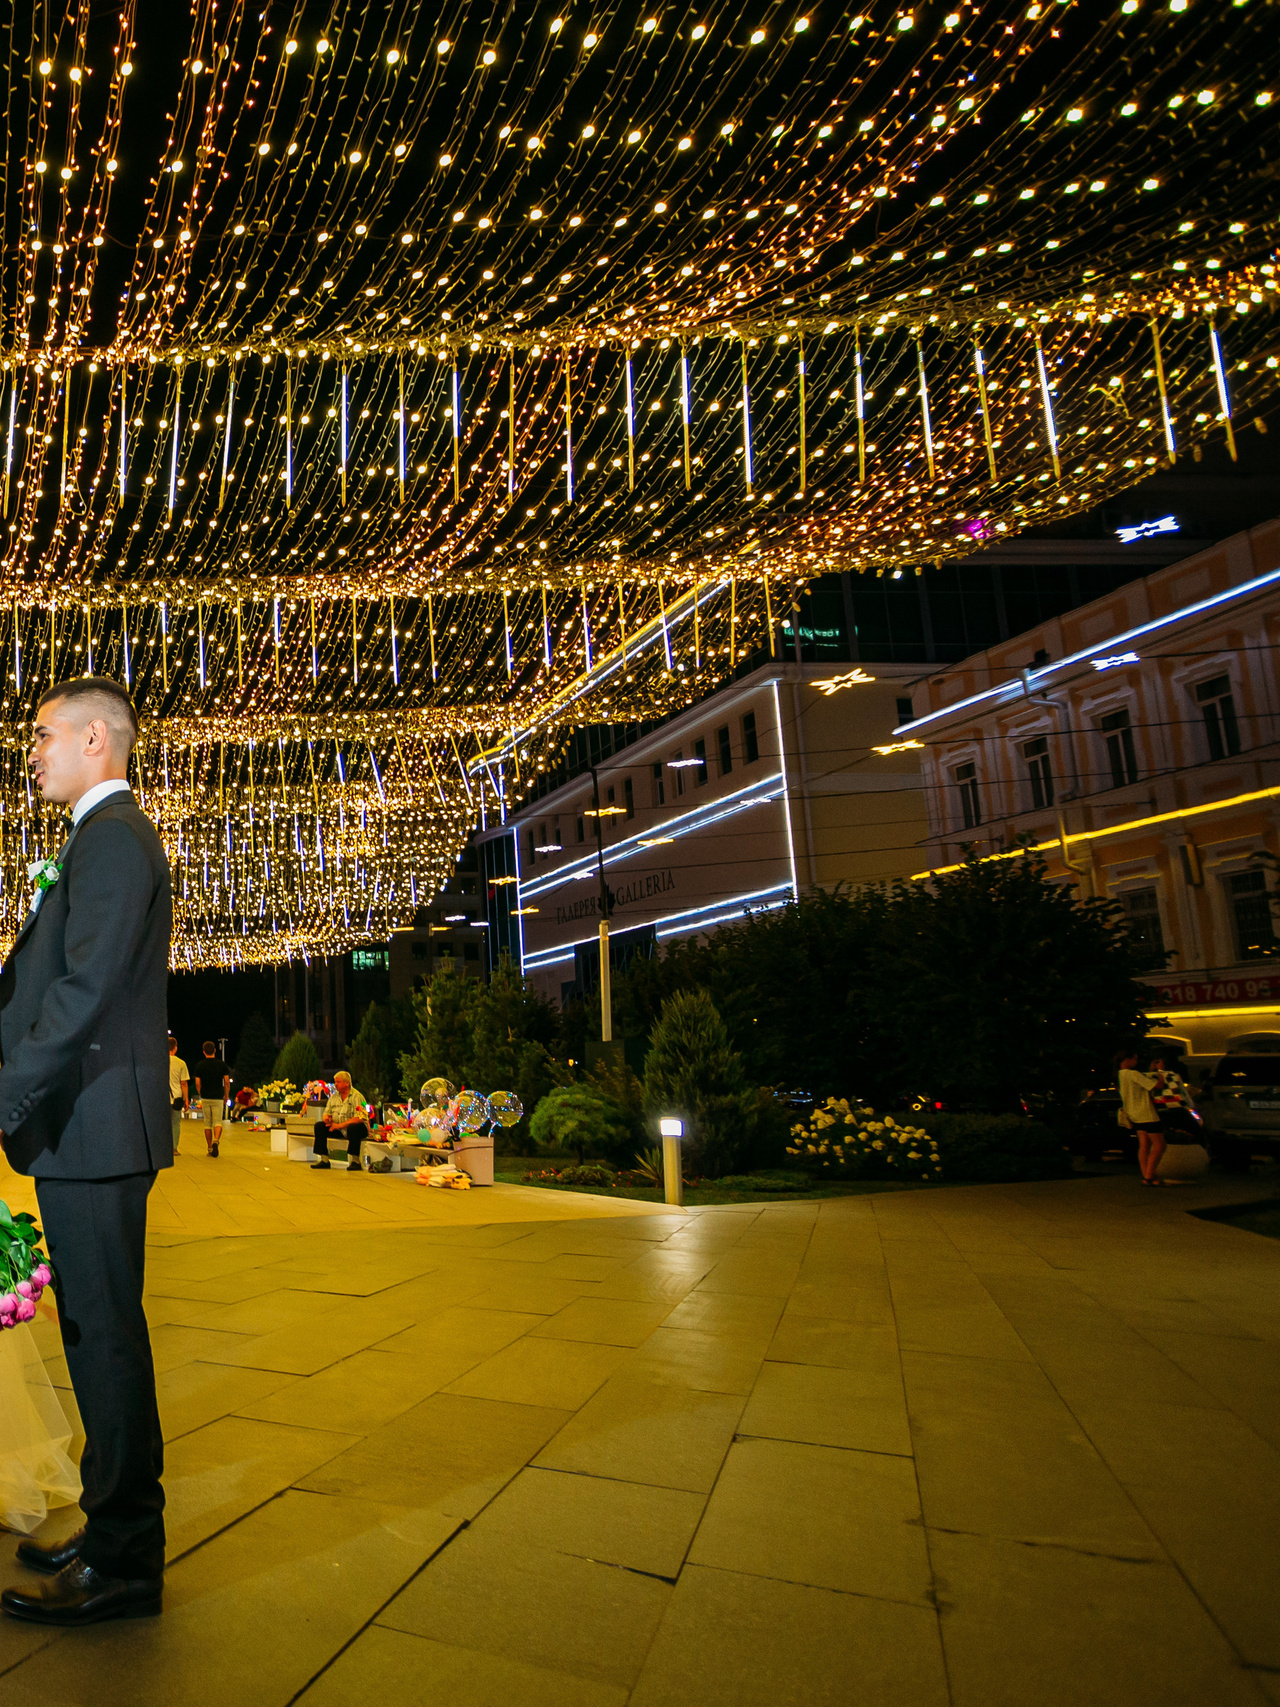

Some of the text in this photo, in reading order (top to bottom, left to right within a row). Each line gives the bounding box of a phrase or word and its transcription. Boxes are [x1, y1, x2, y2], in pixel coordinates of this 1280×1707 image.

[616, 870, 676, 906] GALLERIA
[557, 896, 597, 925] ГАЛЕРЕЯ
[1201, 982, 1240, 1001] 740
